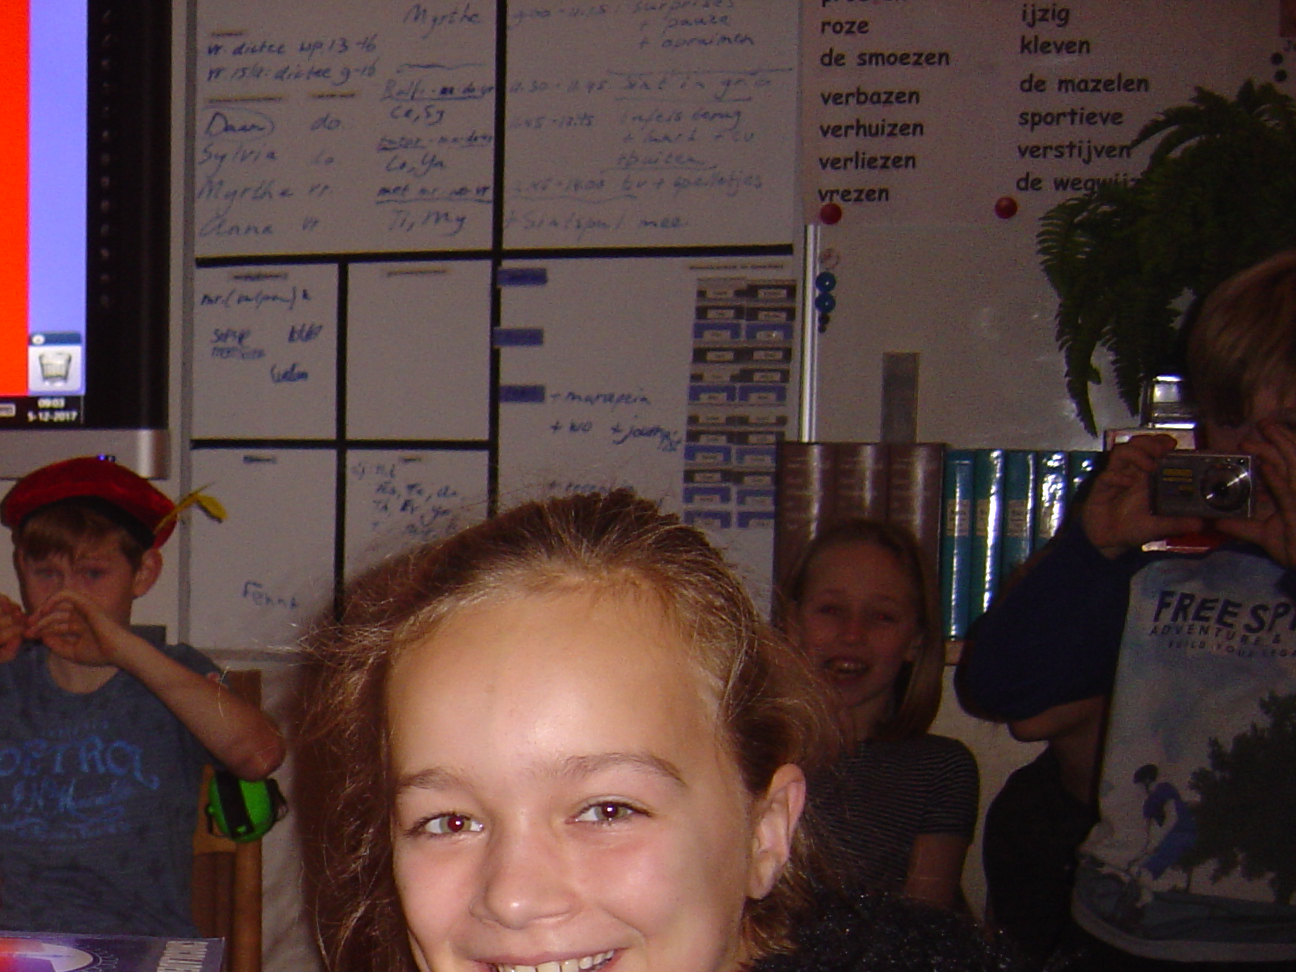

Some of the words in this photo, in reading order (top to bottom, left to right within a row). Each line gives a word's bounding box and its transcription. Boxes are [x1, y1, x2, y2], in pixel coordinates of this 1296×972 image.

[1021, 3, 1071, 28] ijzig
[819, 19, 870, 36] roze
[1019, 34, 1091, 55] kleven
[819, 46, 846, 67] de
[856, 50, 951, 68] smoezen
[1019, 72, 1047, 93] de
[1057, 72, 1150, 94] mazelen
[819, 85, 921, 106] verbazen
[818, 118, 925, 139] verhuizen
[1018, 107, 1124, 133] sportieve
[818, 150, 918, 171] verliezen
[1017, 140, 1133, 165] verstijven
[1015, 171, 1043, 191] de
[817, 186, 890, 203] vrezen
[1153, 590, 1243, 630] FREE
